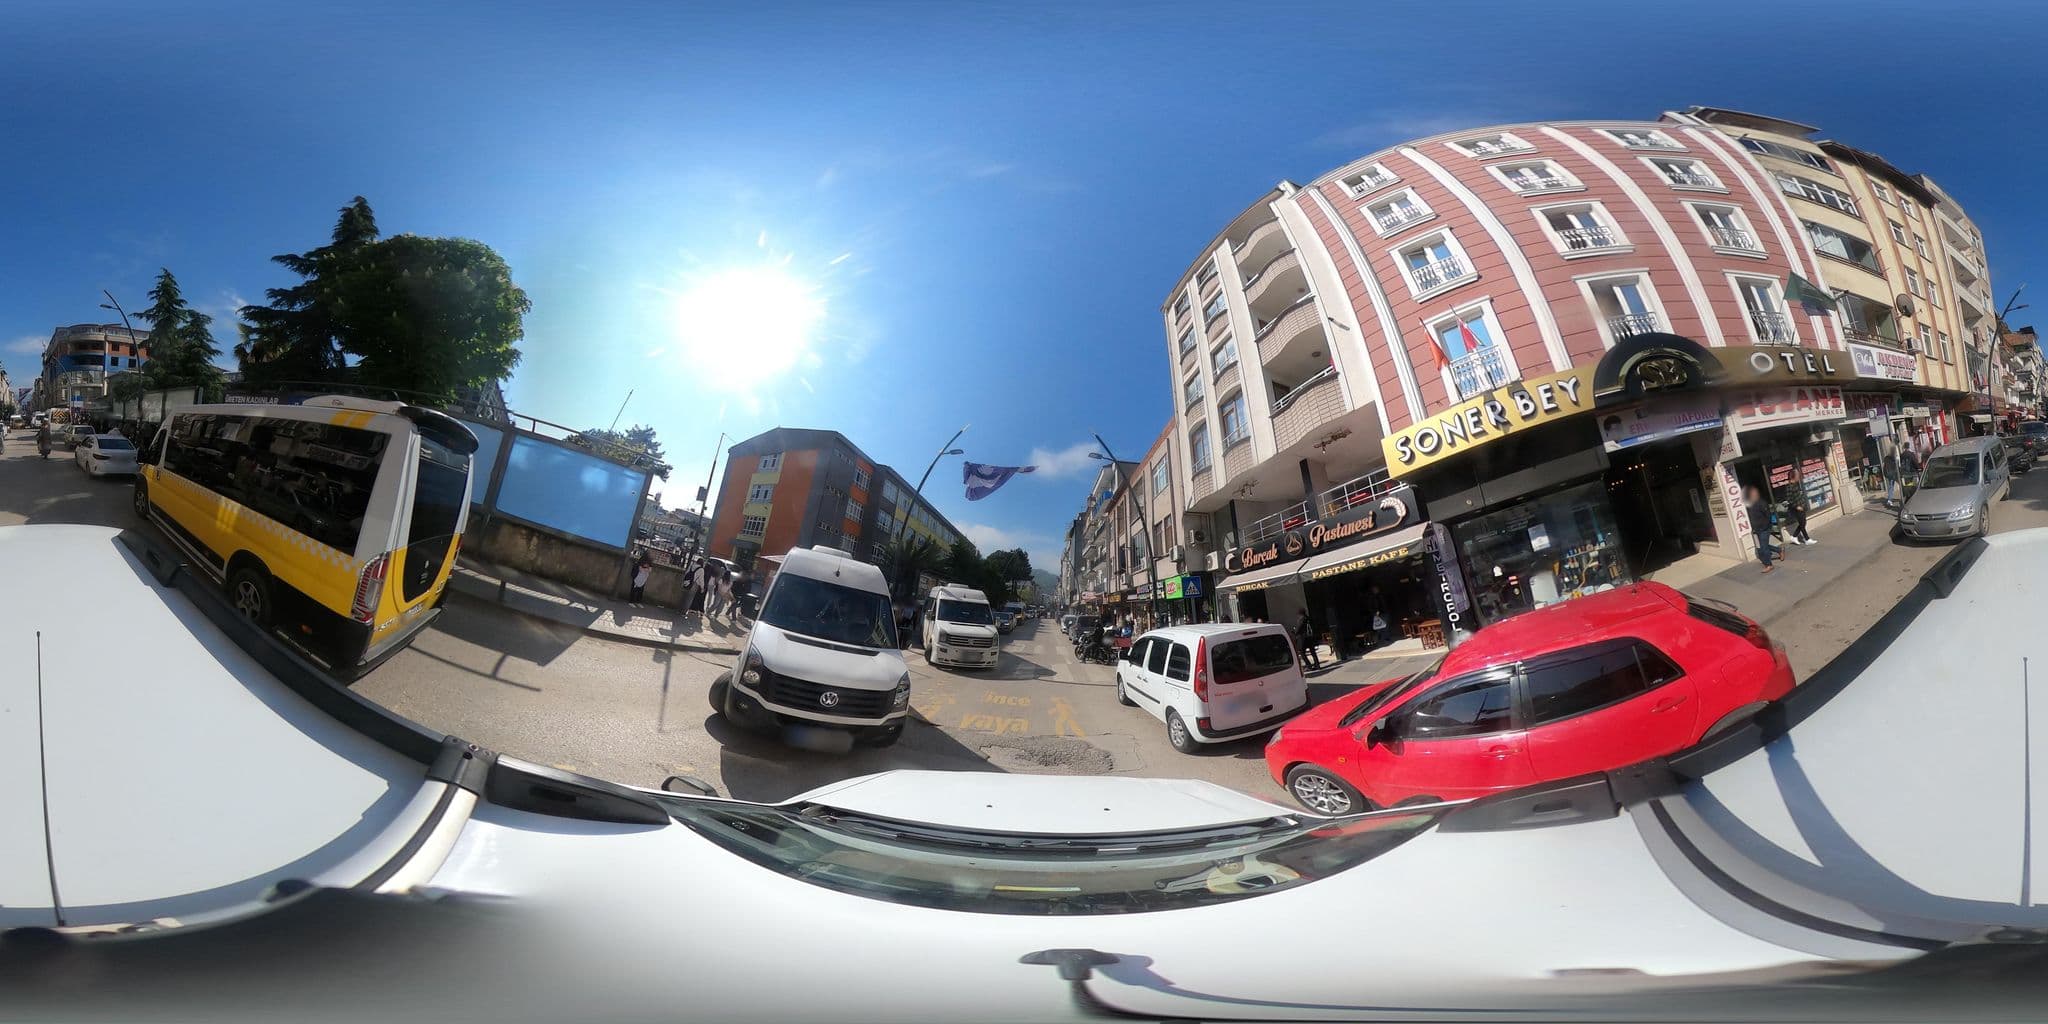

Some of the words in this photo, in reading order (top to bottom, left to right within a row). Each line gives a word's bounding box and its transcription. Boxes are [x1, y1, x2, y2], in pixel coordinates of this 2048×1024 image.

[1751, 352, 1836, 374] OTEL
[1395, 400, 1509, 465] SONER
[1512, 376, 1582, 421] BEY
[1241, 542, 1278, 568] Burçak
[1309, 510, 1376, 548] Pastanesi
[1311, 558, 1367, 579] PASTANE
[1369, 547, 1409, 566] KAFE
